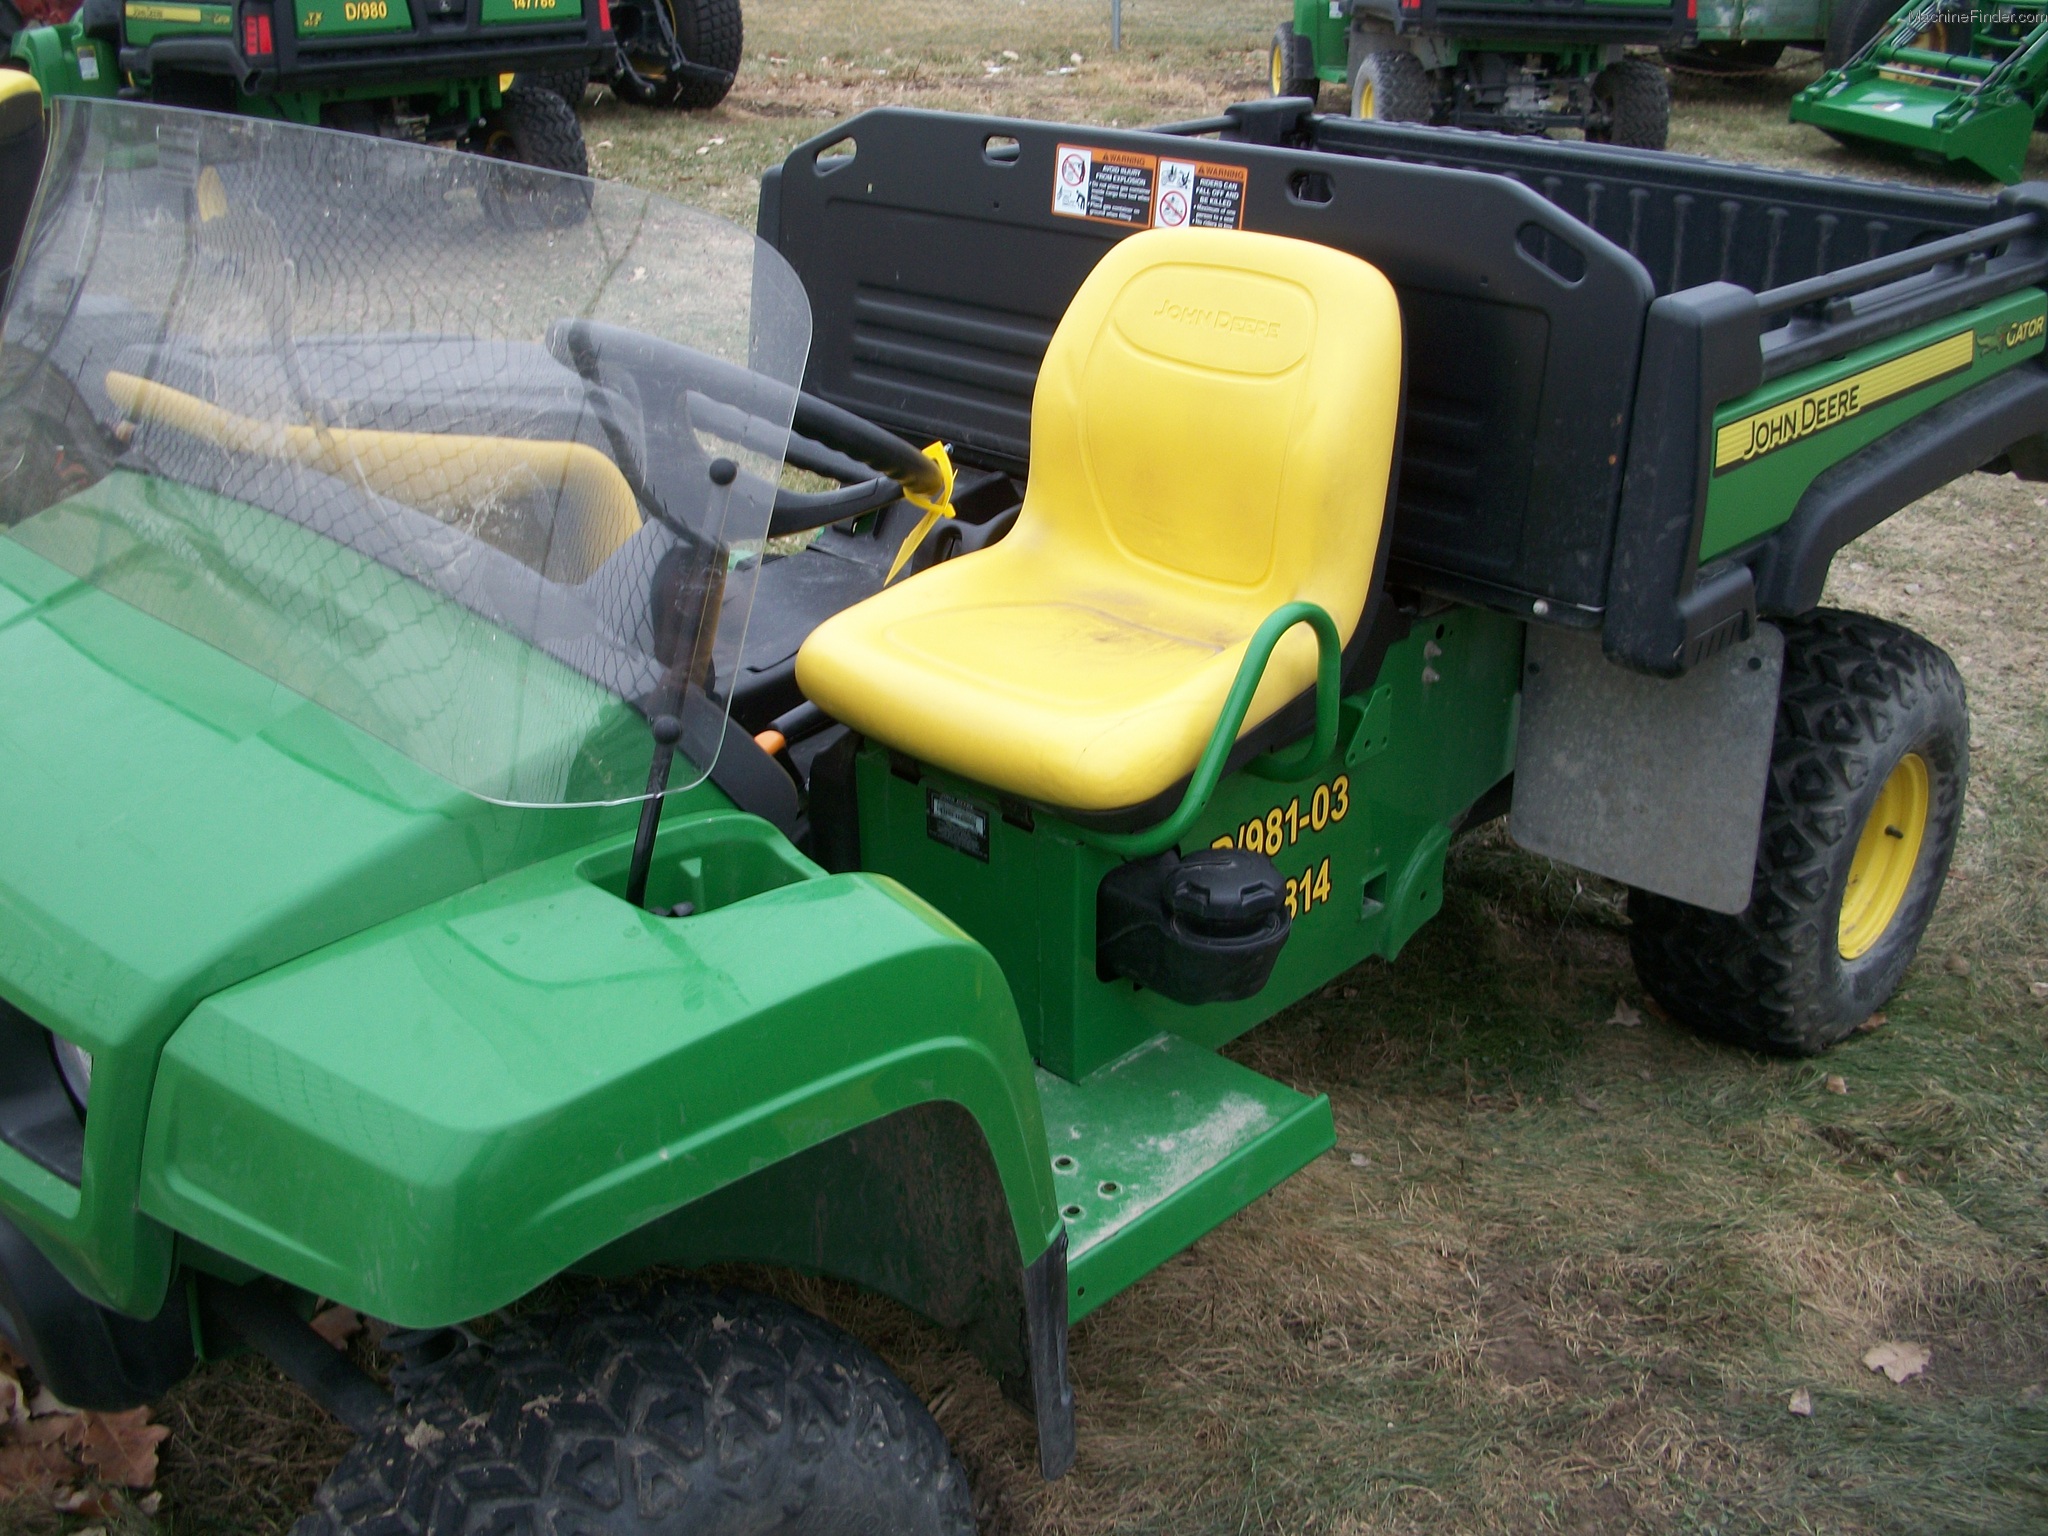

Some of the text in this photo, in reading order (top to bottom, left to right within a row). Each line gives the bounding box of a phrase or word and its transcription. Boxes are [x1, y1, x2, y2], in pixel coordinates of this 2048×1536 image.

[345, 1, 388, 21] D/980
[1110, 153, 1145, 166] WARNING
[1206, 166, 1244, 179] WARNING
[1195, 186, 1239, 200] FALL OFF AND
[1223, 181, 1238, 191] CAN
[1153, 299, 1281, 338] JOHN DEERE
[2006, 315, 2045, 348] GATOR
[1743, 384, 1860, 456] JOHN DEERE
